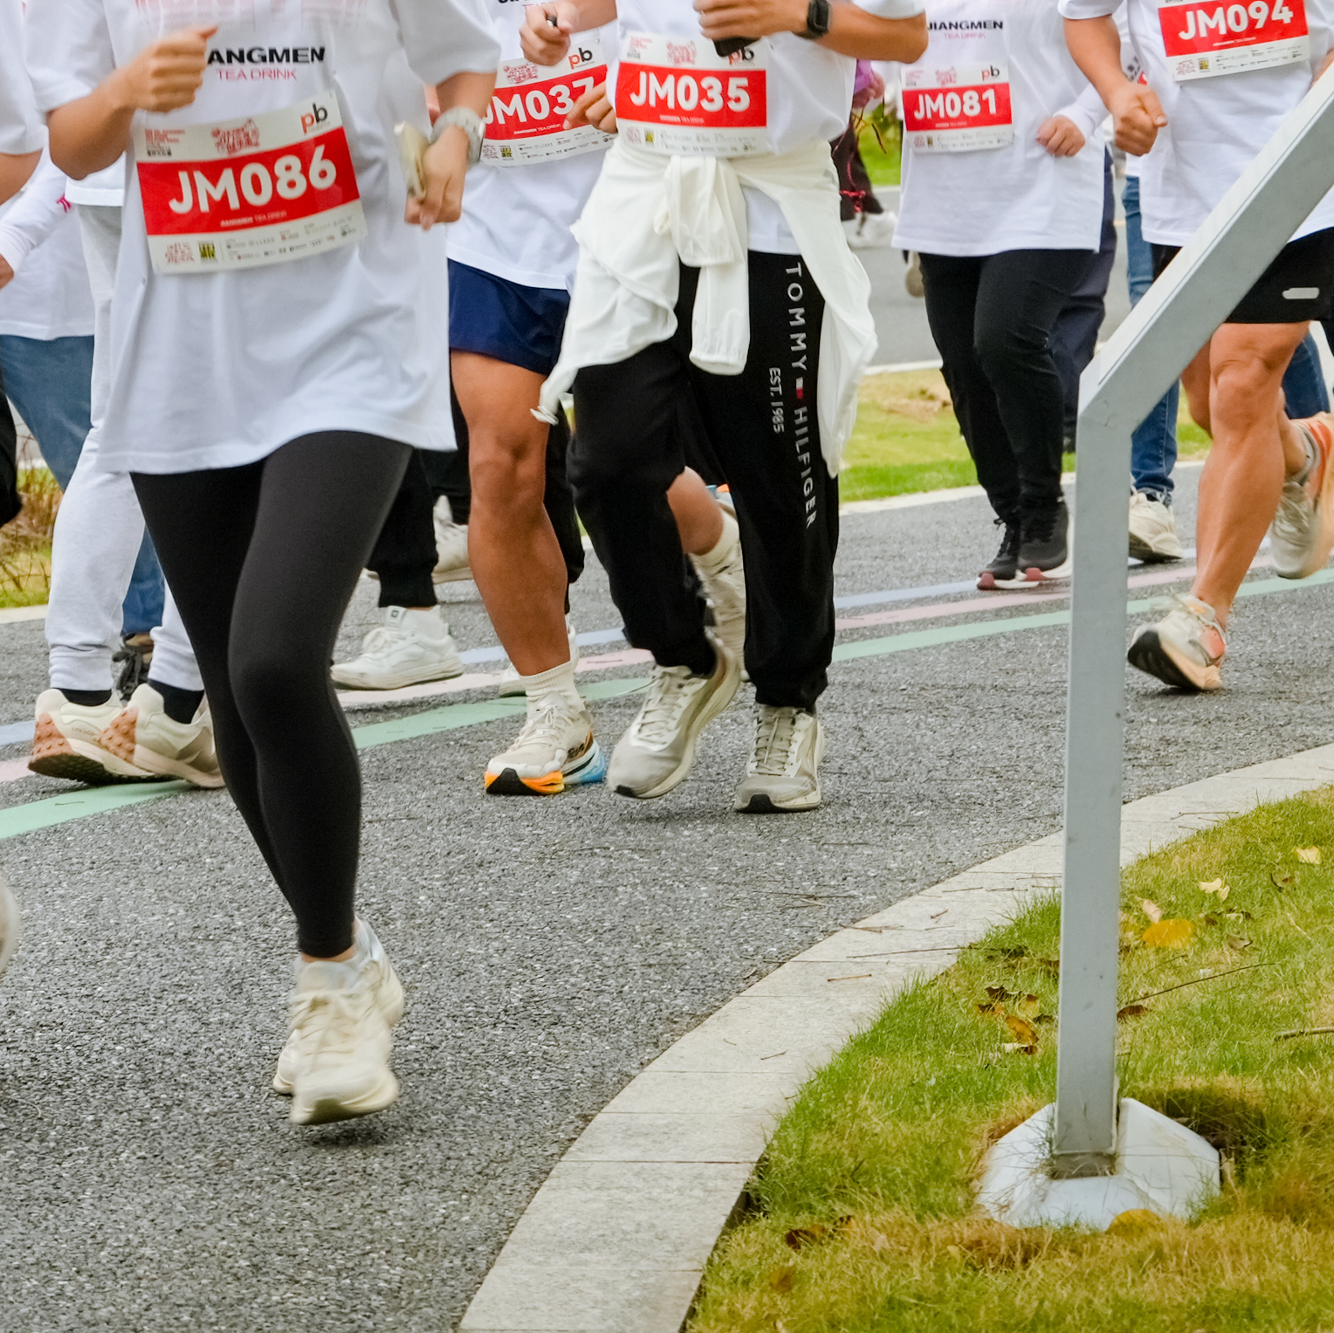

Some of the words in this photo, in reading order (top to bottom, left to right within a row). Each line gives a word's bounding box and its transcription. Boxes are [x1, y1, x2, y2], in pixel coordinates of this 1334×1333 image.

[927, 19, 1004, 32] JIANGMEN
[217, 68, 248, 82] TEA
[250, 67, 298, 81] DRINK
[629, 70, 751, 113] JM035
[913, 88, 997, 120] JM081
[168, 143, 337, 215] JM086
[785, 261, 808, 371] TOMMY
[768, 366, 782, 398] EST.
[770, 400, 785, 435] 1985
[793, 405, 817, 530] HILFIGER
